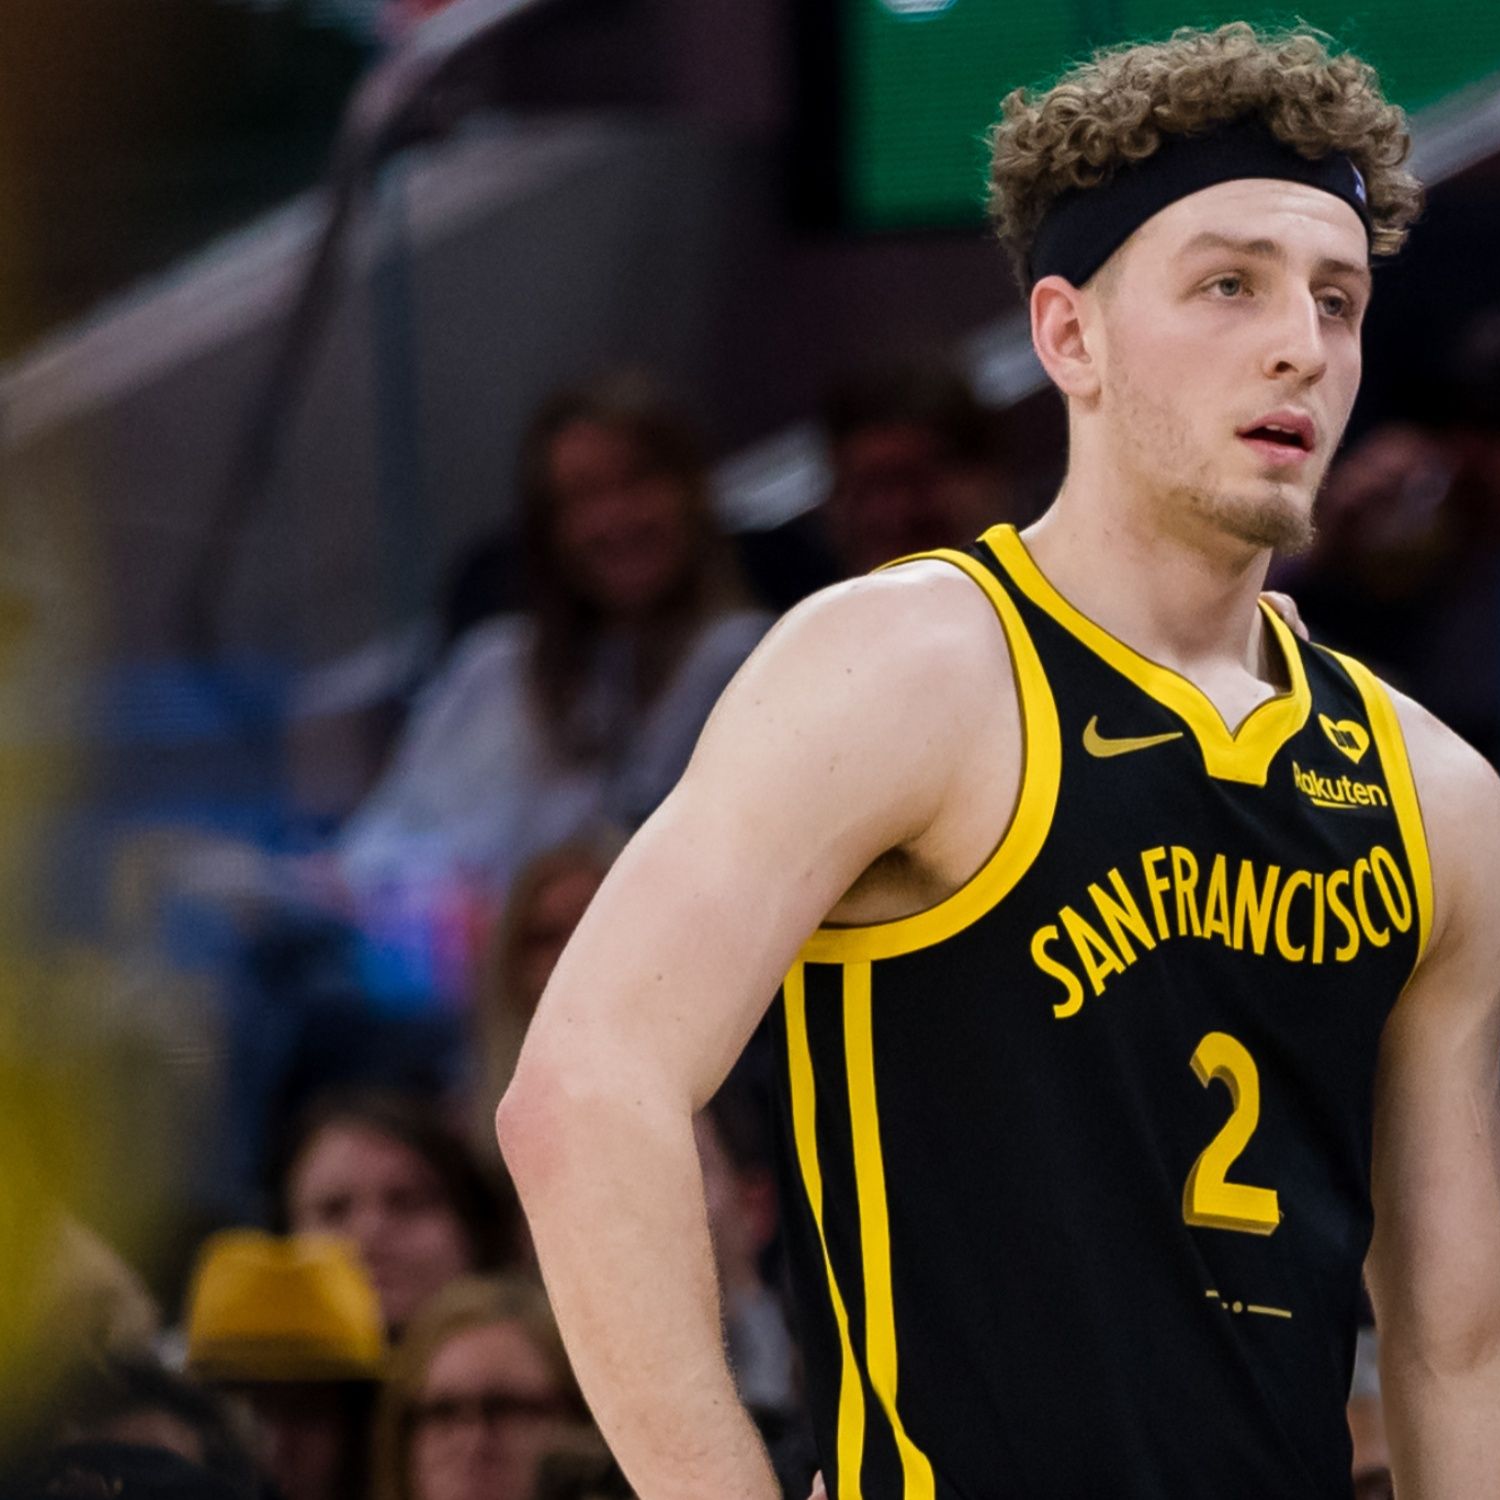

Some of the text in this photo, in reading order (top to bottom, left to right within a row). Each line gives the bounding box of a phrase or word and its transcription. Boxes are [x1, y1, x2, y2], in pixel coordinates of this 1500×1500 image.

[1292, 760, 1387, 807] Rakuten
[1030, 845, 1412, 1019] SAN FRANCISCO
[1182, 1031, 1280, 1236] 2
